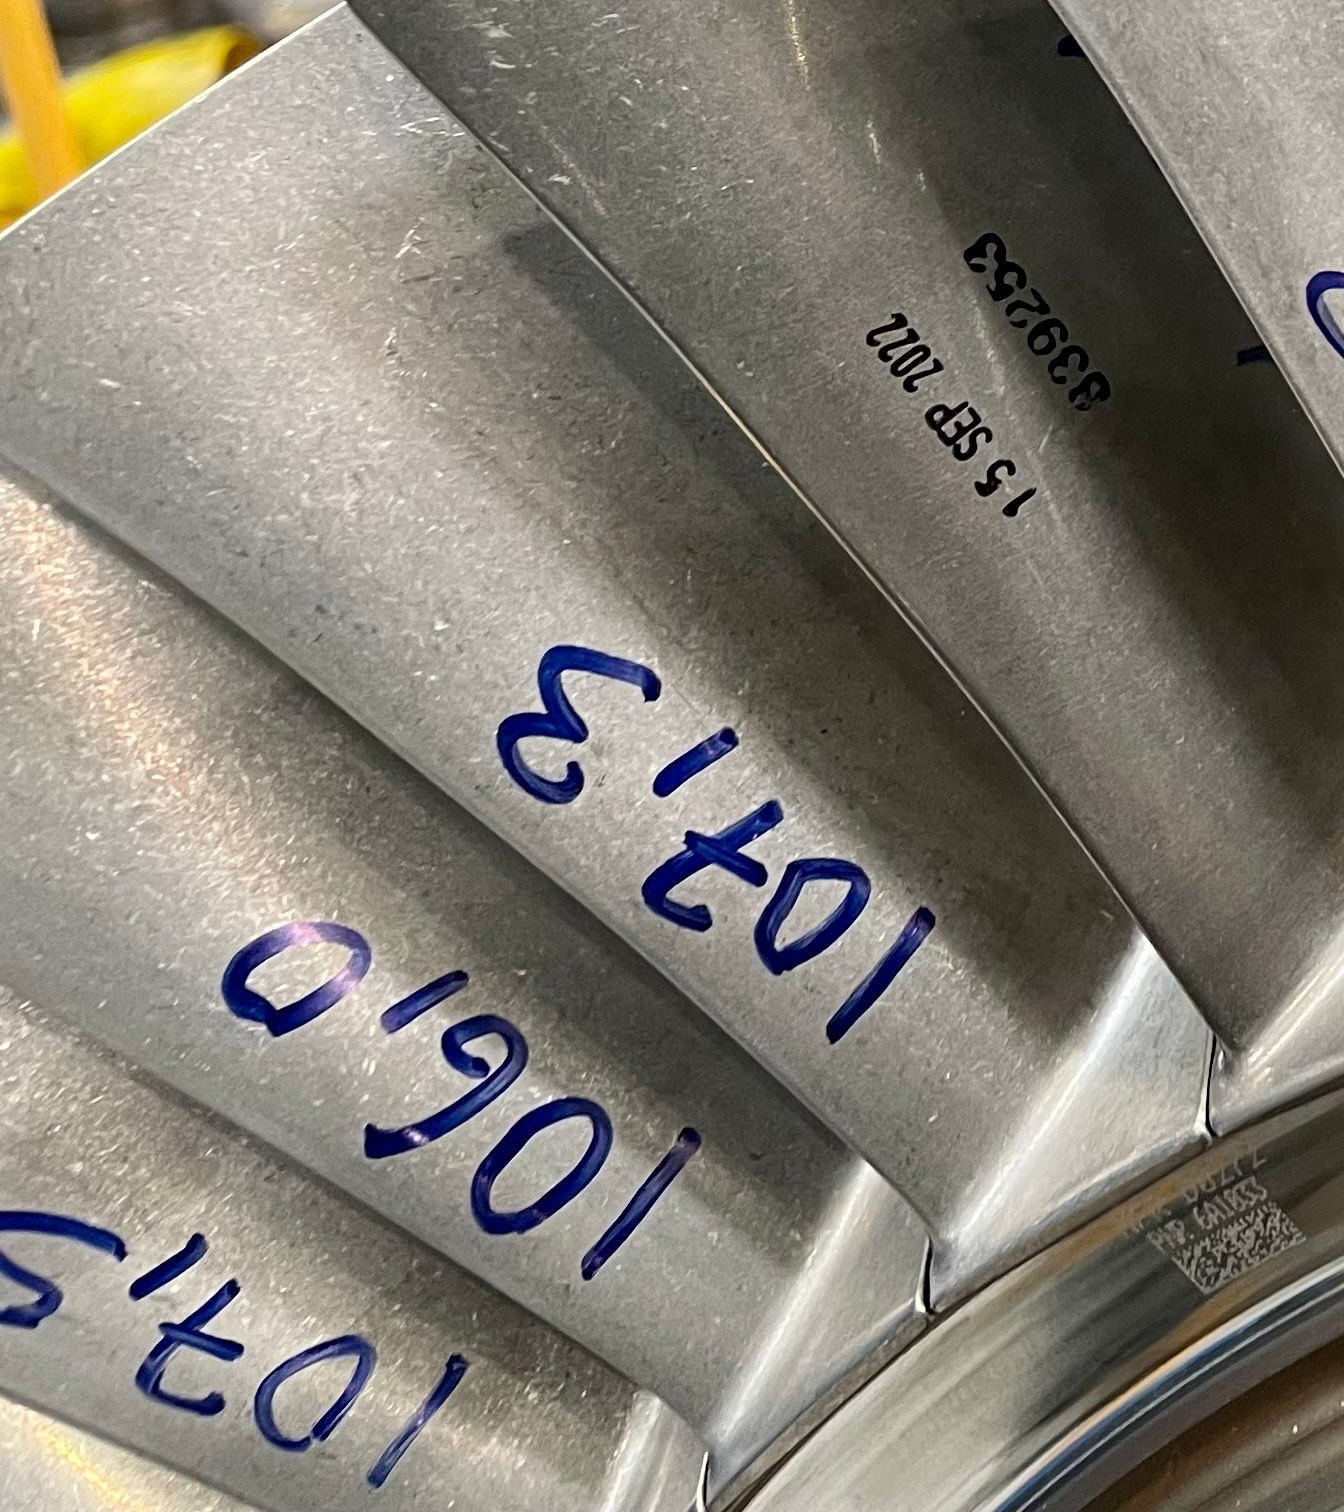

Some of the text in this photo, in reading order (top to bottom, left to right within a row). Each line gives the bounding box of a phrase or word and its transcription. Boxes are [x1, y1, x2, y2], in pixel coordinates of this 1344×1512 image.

[865, 311, 945, 393] 2022
[963, 231, 1112, 412] 839253
[923, 400, 994, 462] SEP
[495, 644, 936, 1045] 107,3
[220, 921, 702, 1280] 106,0
